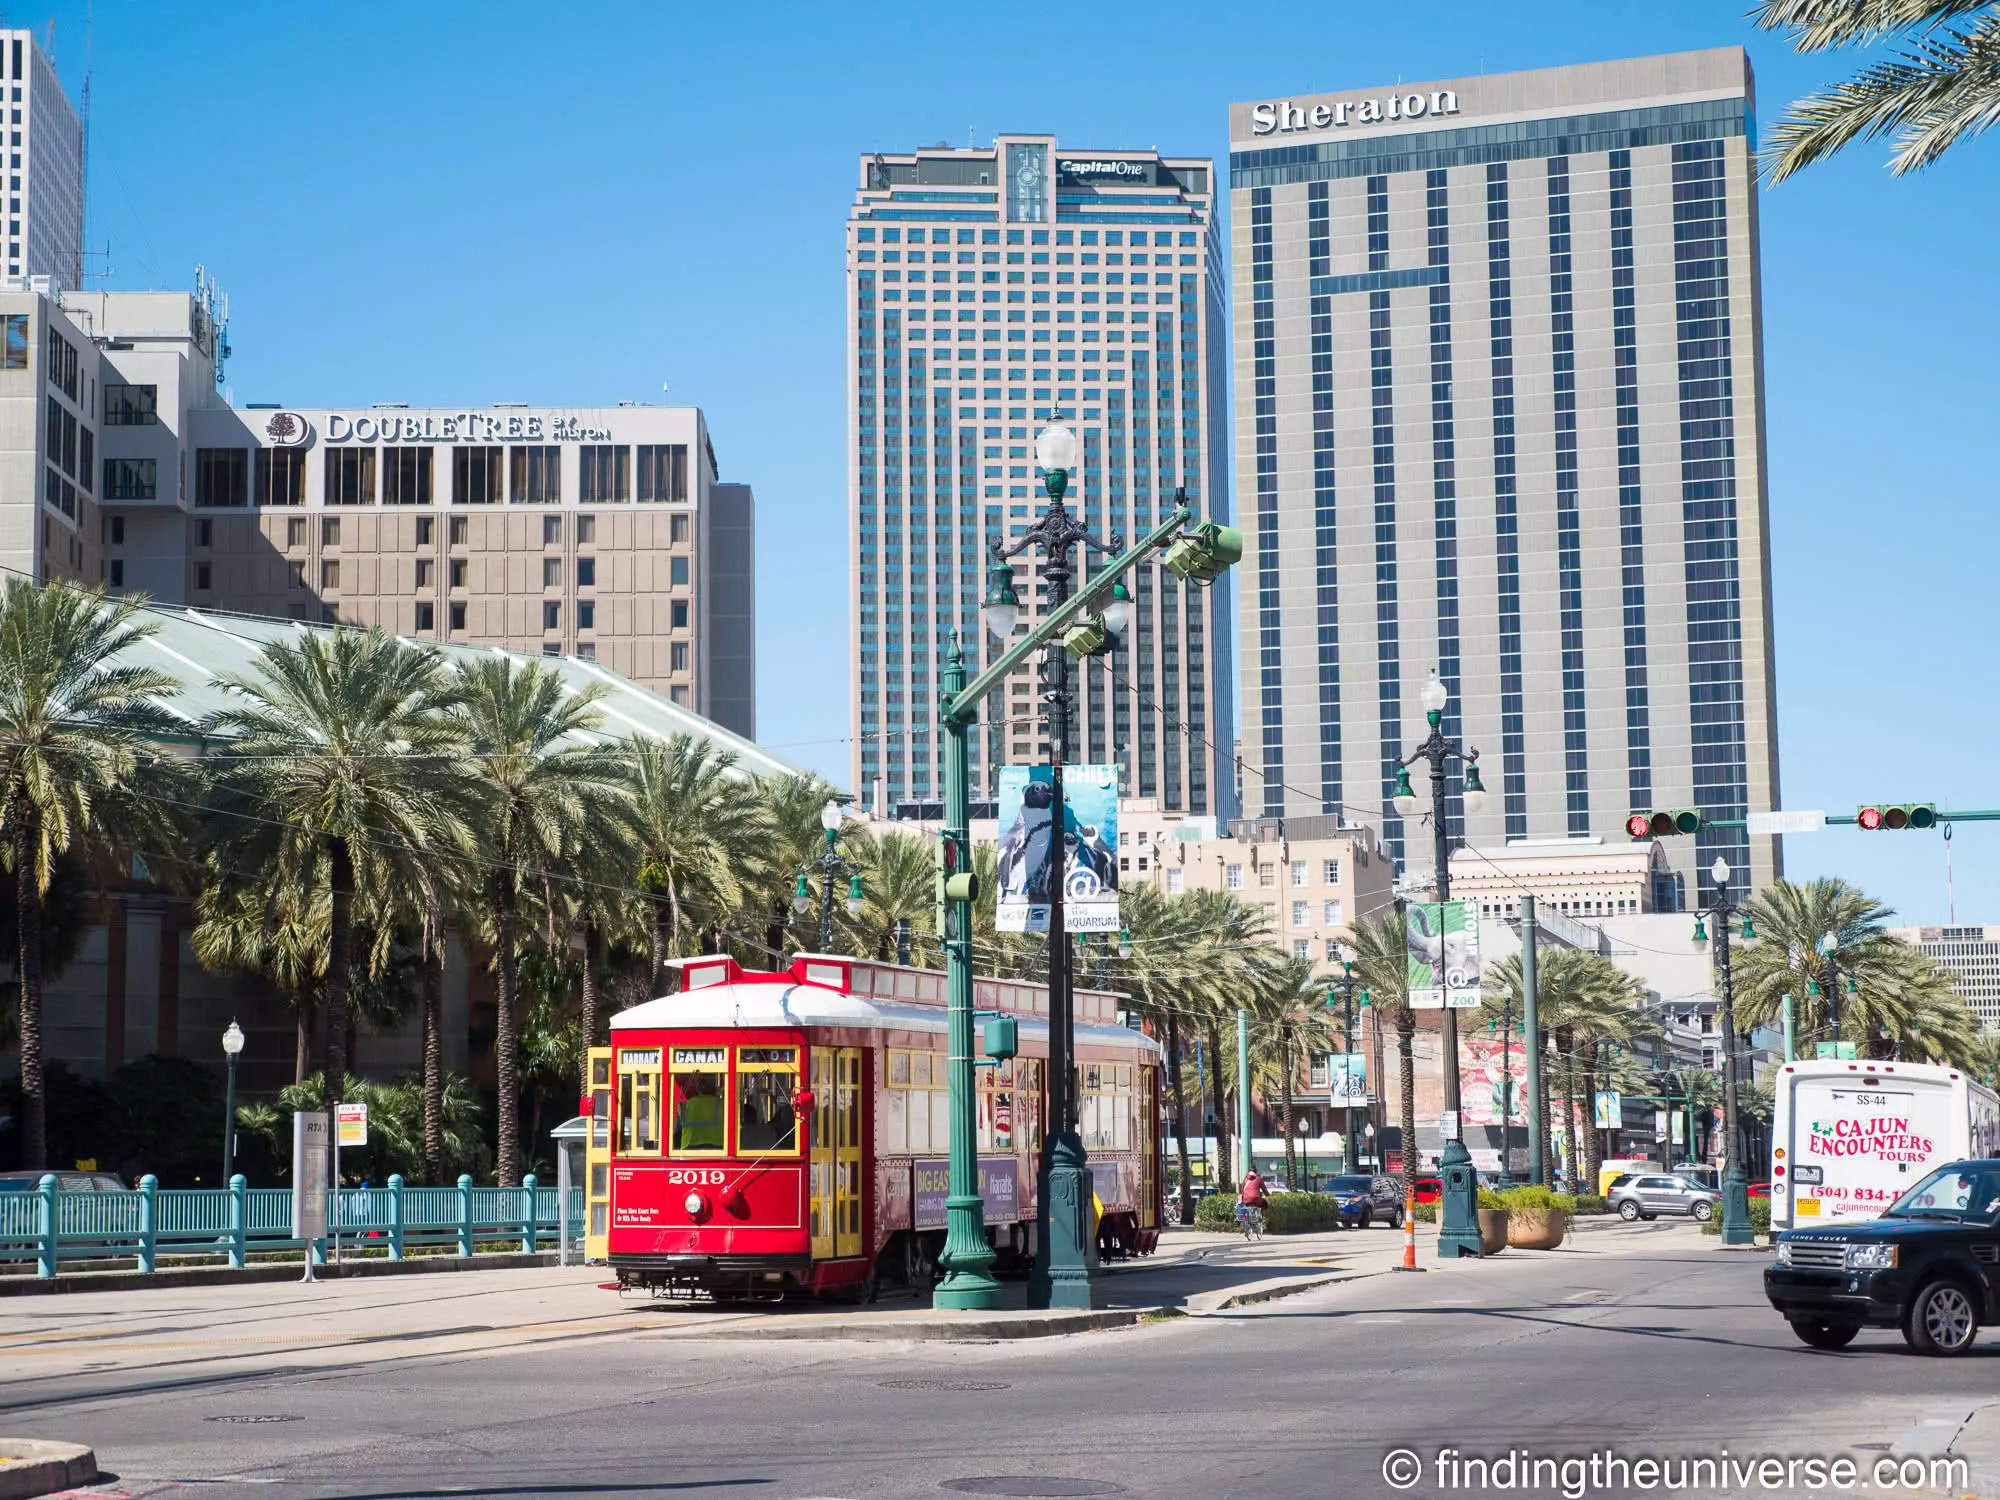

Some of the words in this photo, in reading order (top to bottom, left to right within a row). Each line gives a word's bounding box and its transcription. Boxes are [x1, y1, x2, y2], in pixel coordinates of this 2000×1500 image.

[1252, 89, 1460, 136] Sheraton
[552, 415, 576, 428] BY
[552, 427, 611, 442] HILTON
[1066, 916, 1117, 929] AQUARIUM
[1452, 995, 1475, 1006] ZOO
[675, 1051, 724, 1064] CANAL
[1857, 1094, 1886, 1106] SS-44
[1835, 1117, 1909, 1138] CAJUN
[1809, 1133, 1933, 1157] ENCOUNTERS
[1877, 1151, 1926, 1163] TOURS
[668, 1170, 725, 1185] 2019
[917, 1169, 932, 1193] BIG
[933, 1169, 951, 1192] EAS
[1810, 1186, 1848, 1199] (504)
